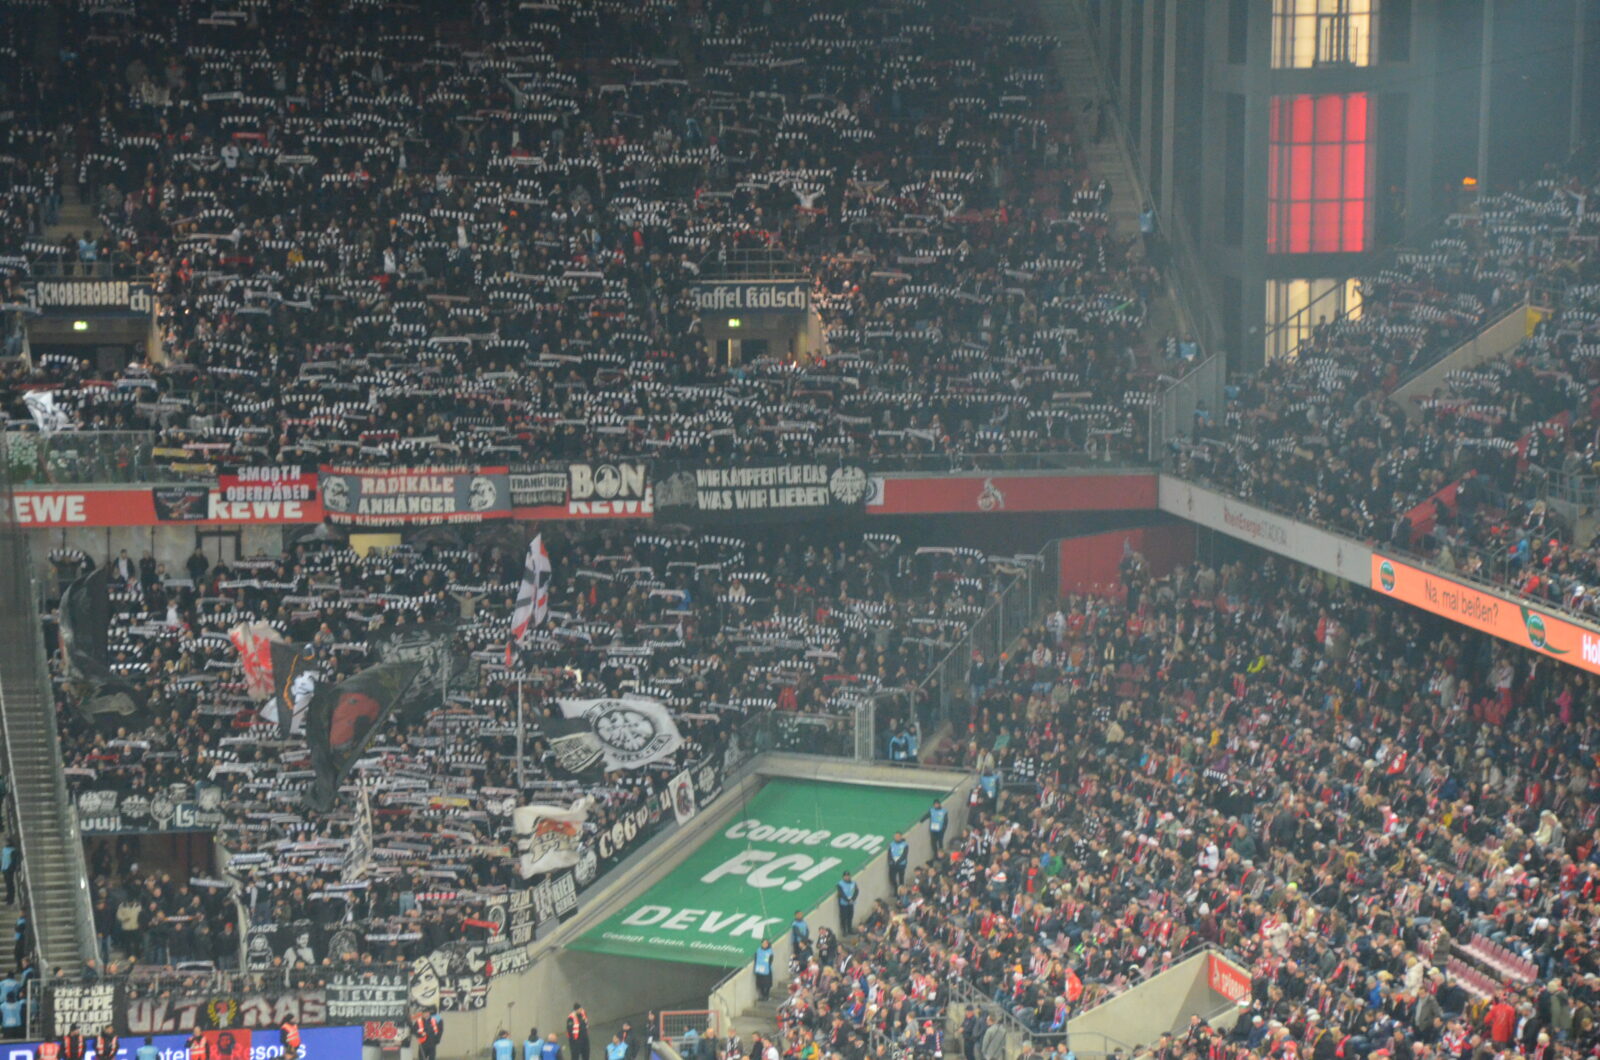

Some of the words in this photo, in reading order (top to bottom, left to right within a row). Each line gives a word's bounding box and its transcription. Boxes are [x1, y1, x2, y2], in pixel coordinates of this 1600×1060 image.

[746, 286, 806, 310] Kölsch
[238, 465, 300, 482] SMOOTH
[361, 476, 454, 494] RADIKALE
[696, 469, 719, 488] WIR
[803, 465, 828, 483] DAS
[208, 492, 303, 519] REWE
[358, 494, 456, 514] ANHÄNGER
[697, 490, 732, 510] WAS
[734, 489, 767, 509] WIR
[769, 487, 830, 507] LIEBEN
[1425, 578, 1440, 609] Na,
[1443, 589, 1459, 610] mal
[725, 819, 831, 845] Come
[830, 832, 885, 854] on,
[701, 849, 842, 892] FC!
[621, 904, 784, 939] DEVK
[334, 974, 401, 986] ULTRAS
[339, 989, 396, 1001] NEVER
[329, 1004, 403, 1017] SURRENDER
